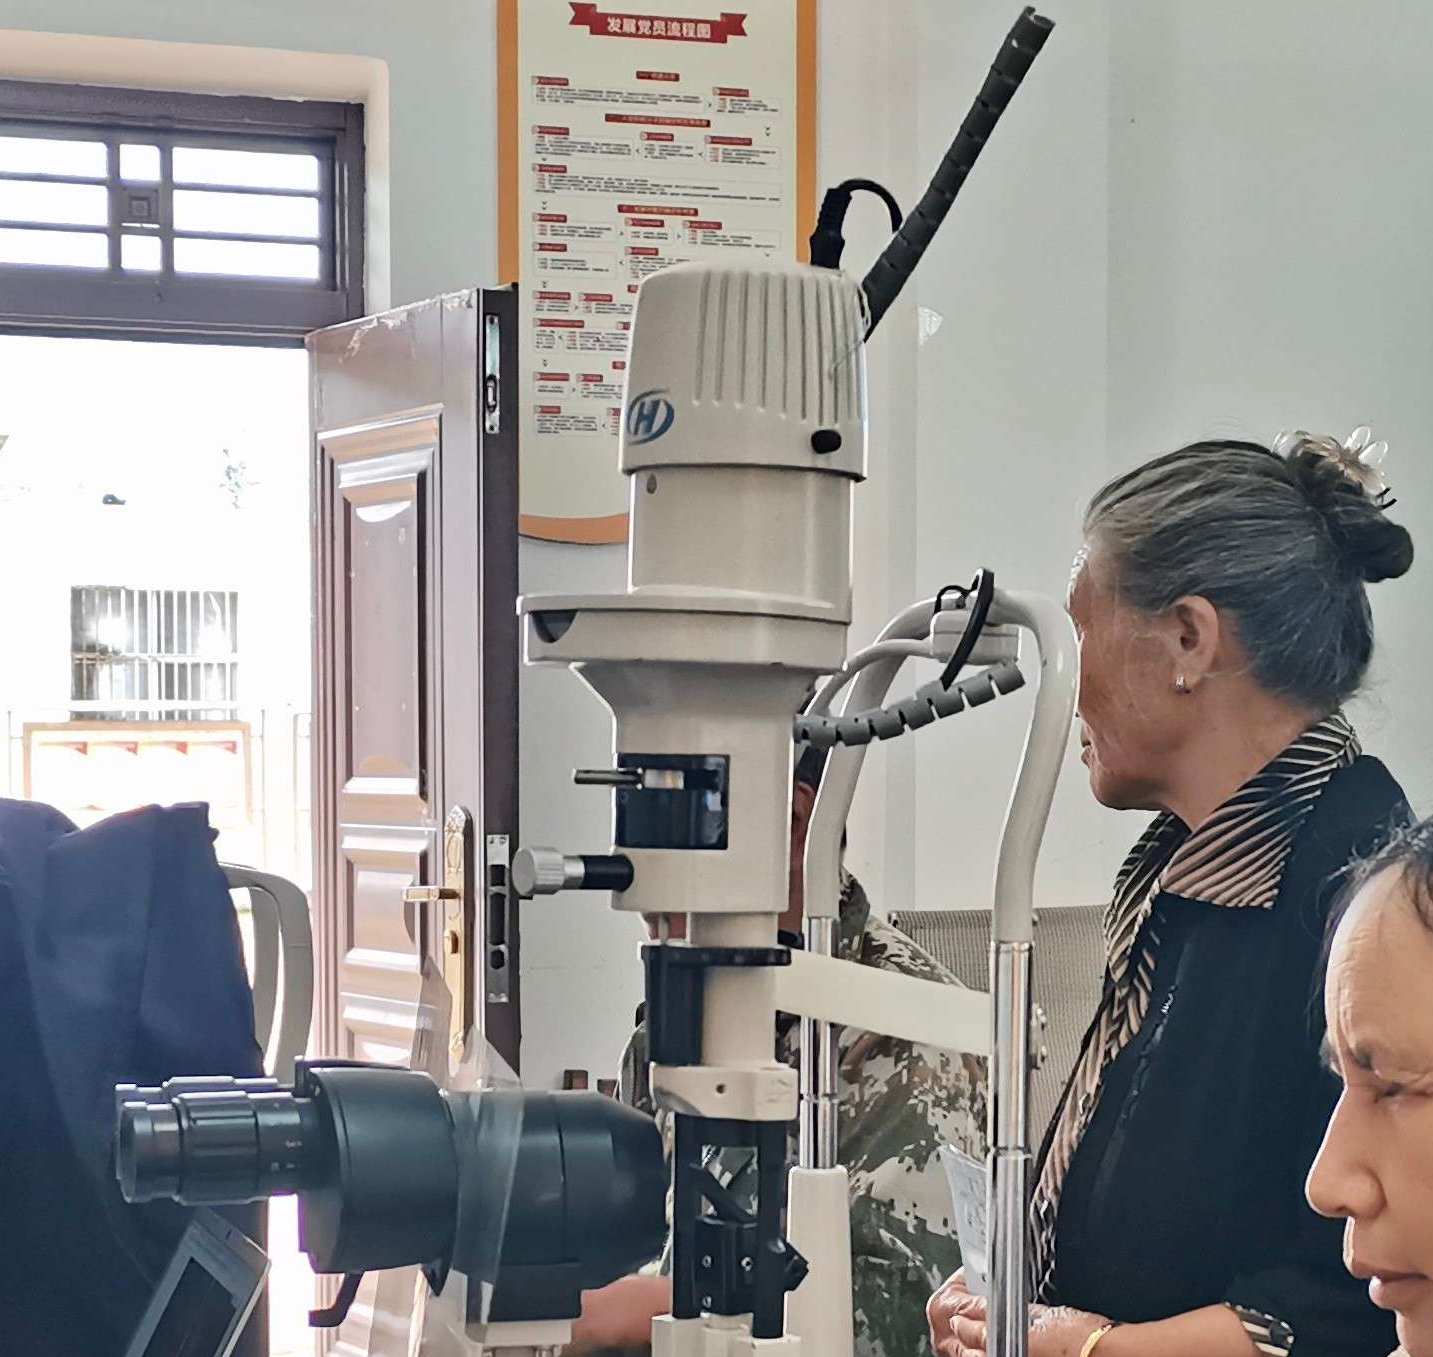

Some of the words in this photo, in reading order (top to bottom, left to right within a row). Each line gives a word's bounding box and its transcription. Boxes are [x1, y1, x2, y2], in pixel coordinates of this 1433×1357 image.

[607, 16, 711, 39] 发展党员流程图
